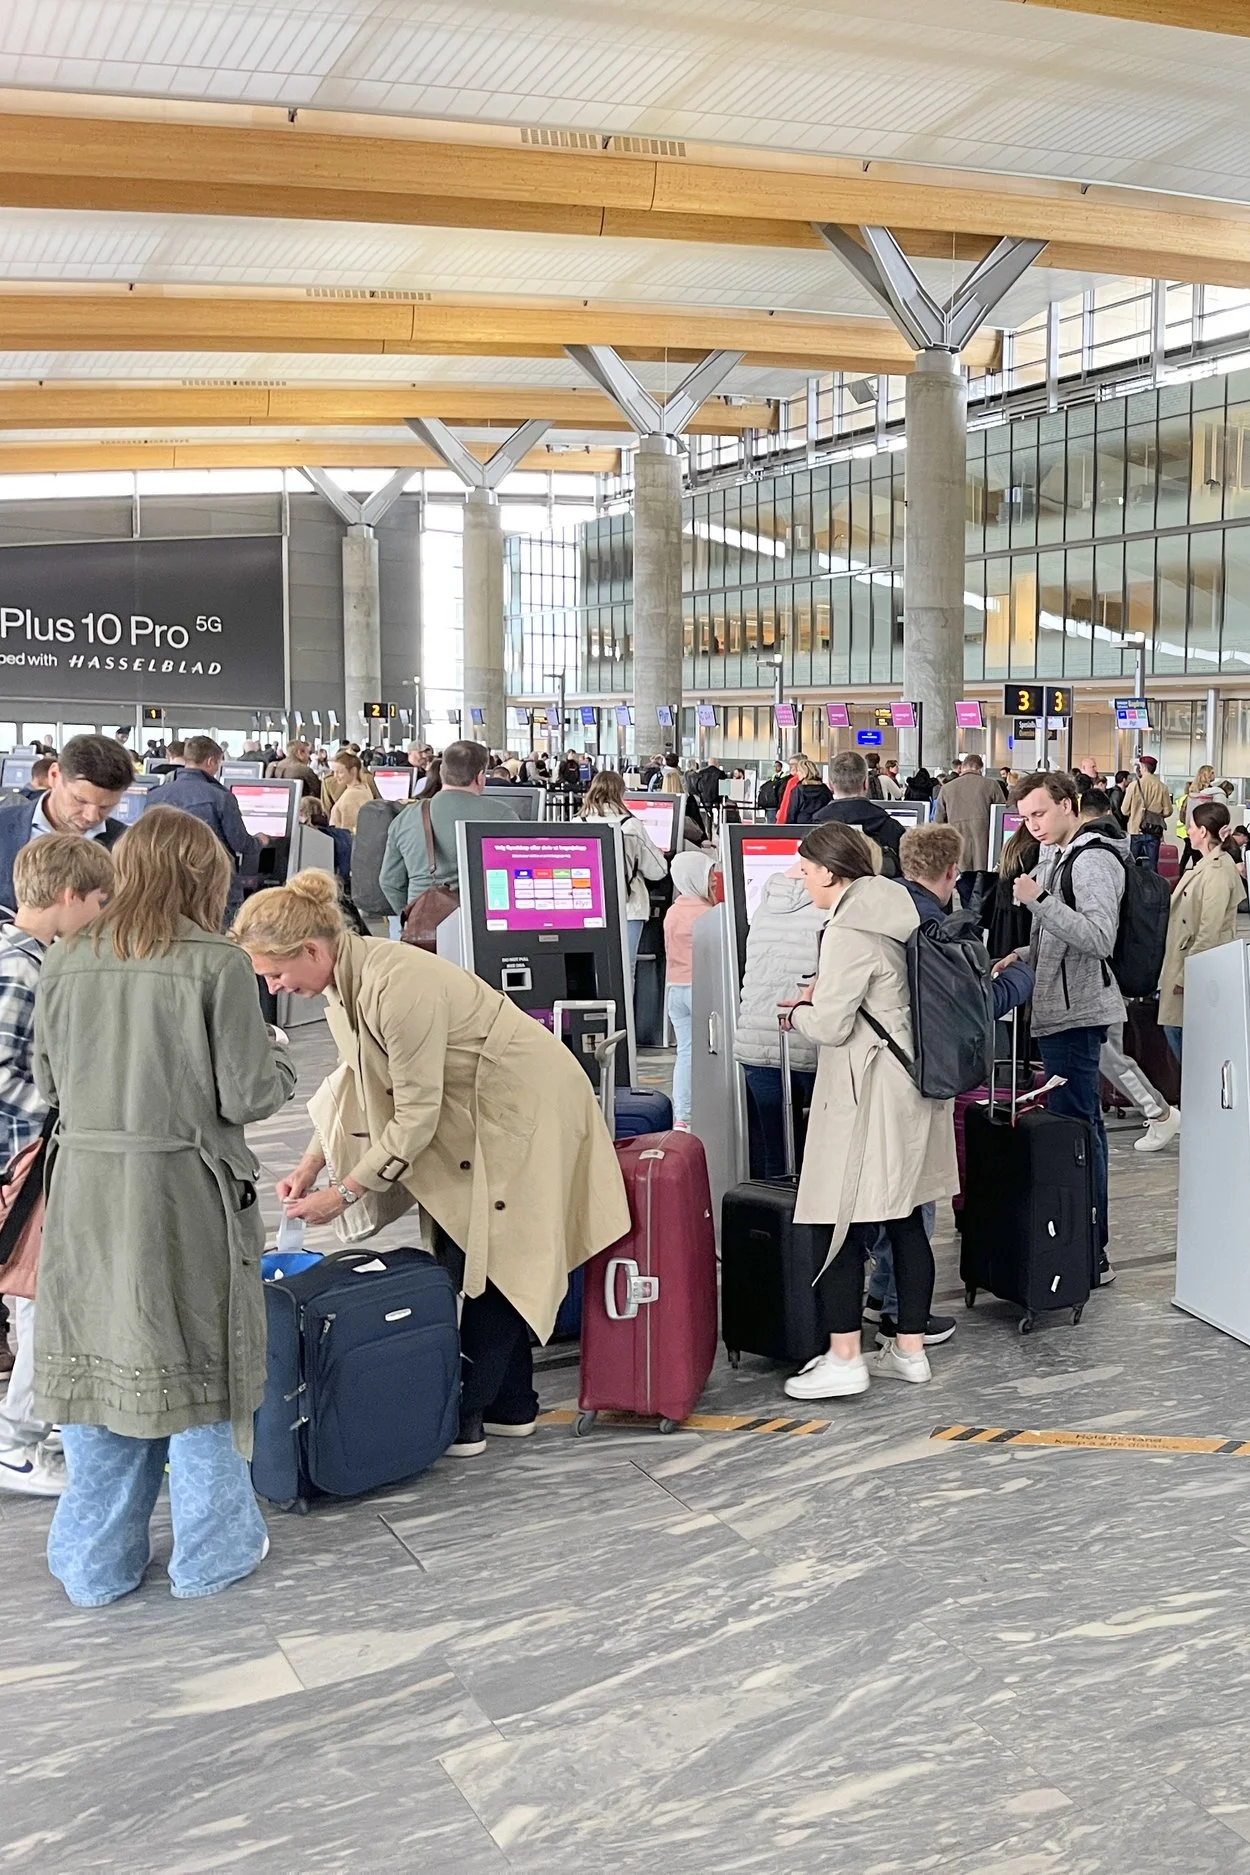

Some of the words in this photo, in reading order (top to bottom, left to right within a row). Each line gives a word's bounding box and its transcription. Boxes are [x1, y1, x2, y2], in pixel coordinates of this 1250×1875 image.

[0, 607, 75, 643] Plus
[81, 612, 122, 645] 10
[130, 615, 189, 649] Pro
[195, 615, 222, 632] 5G
[27, 652, 58, 667] with
[68, 654, 222, 675] HASSELBLAD
[371, 704, 380, 717] 2
[390, 705, 395, 717] 1
[1018, 690, 1030, 711] 3
[1054, 691, 1063, 712] 3
[150, 709, 156, 719] 1
